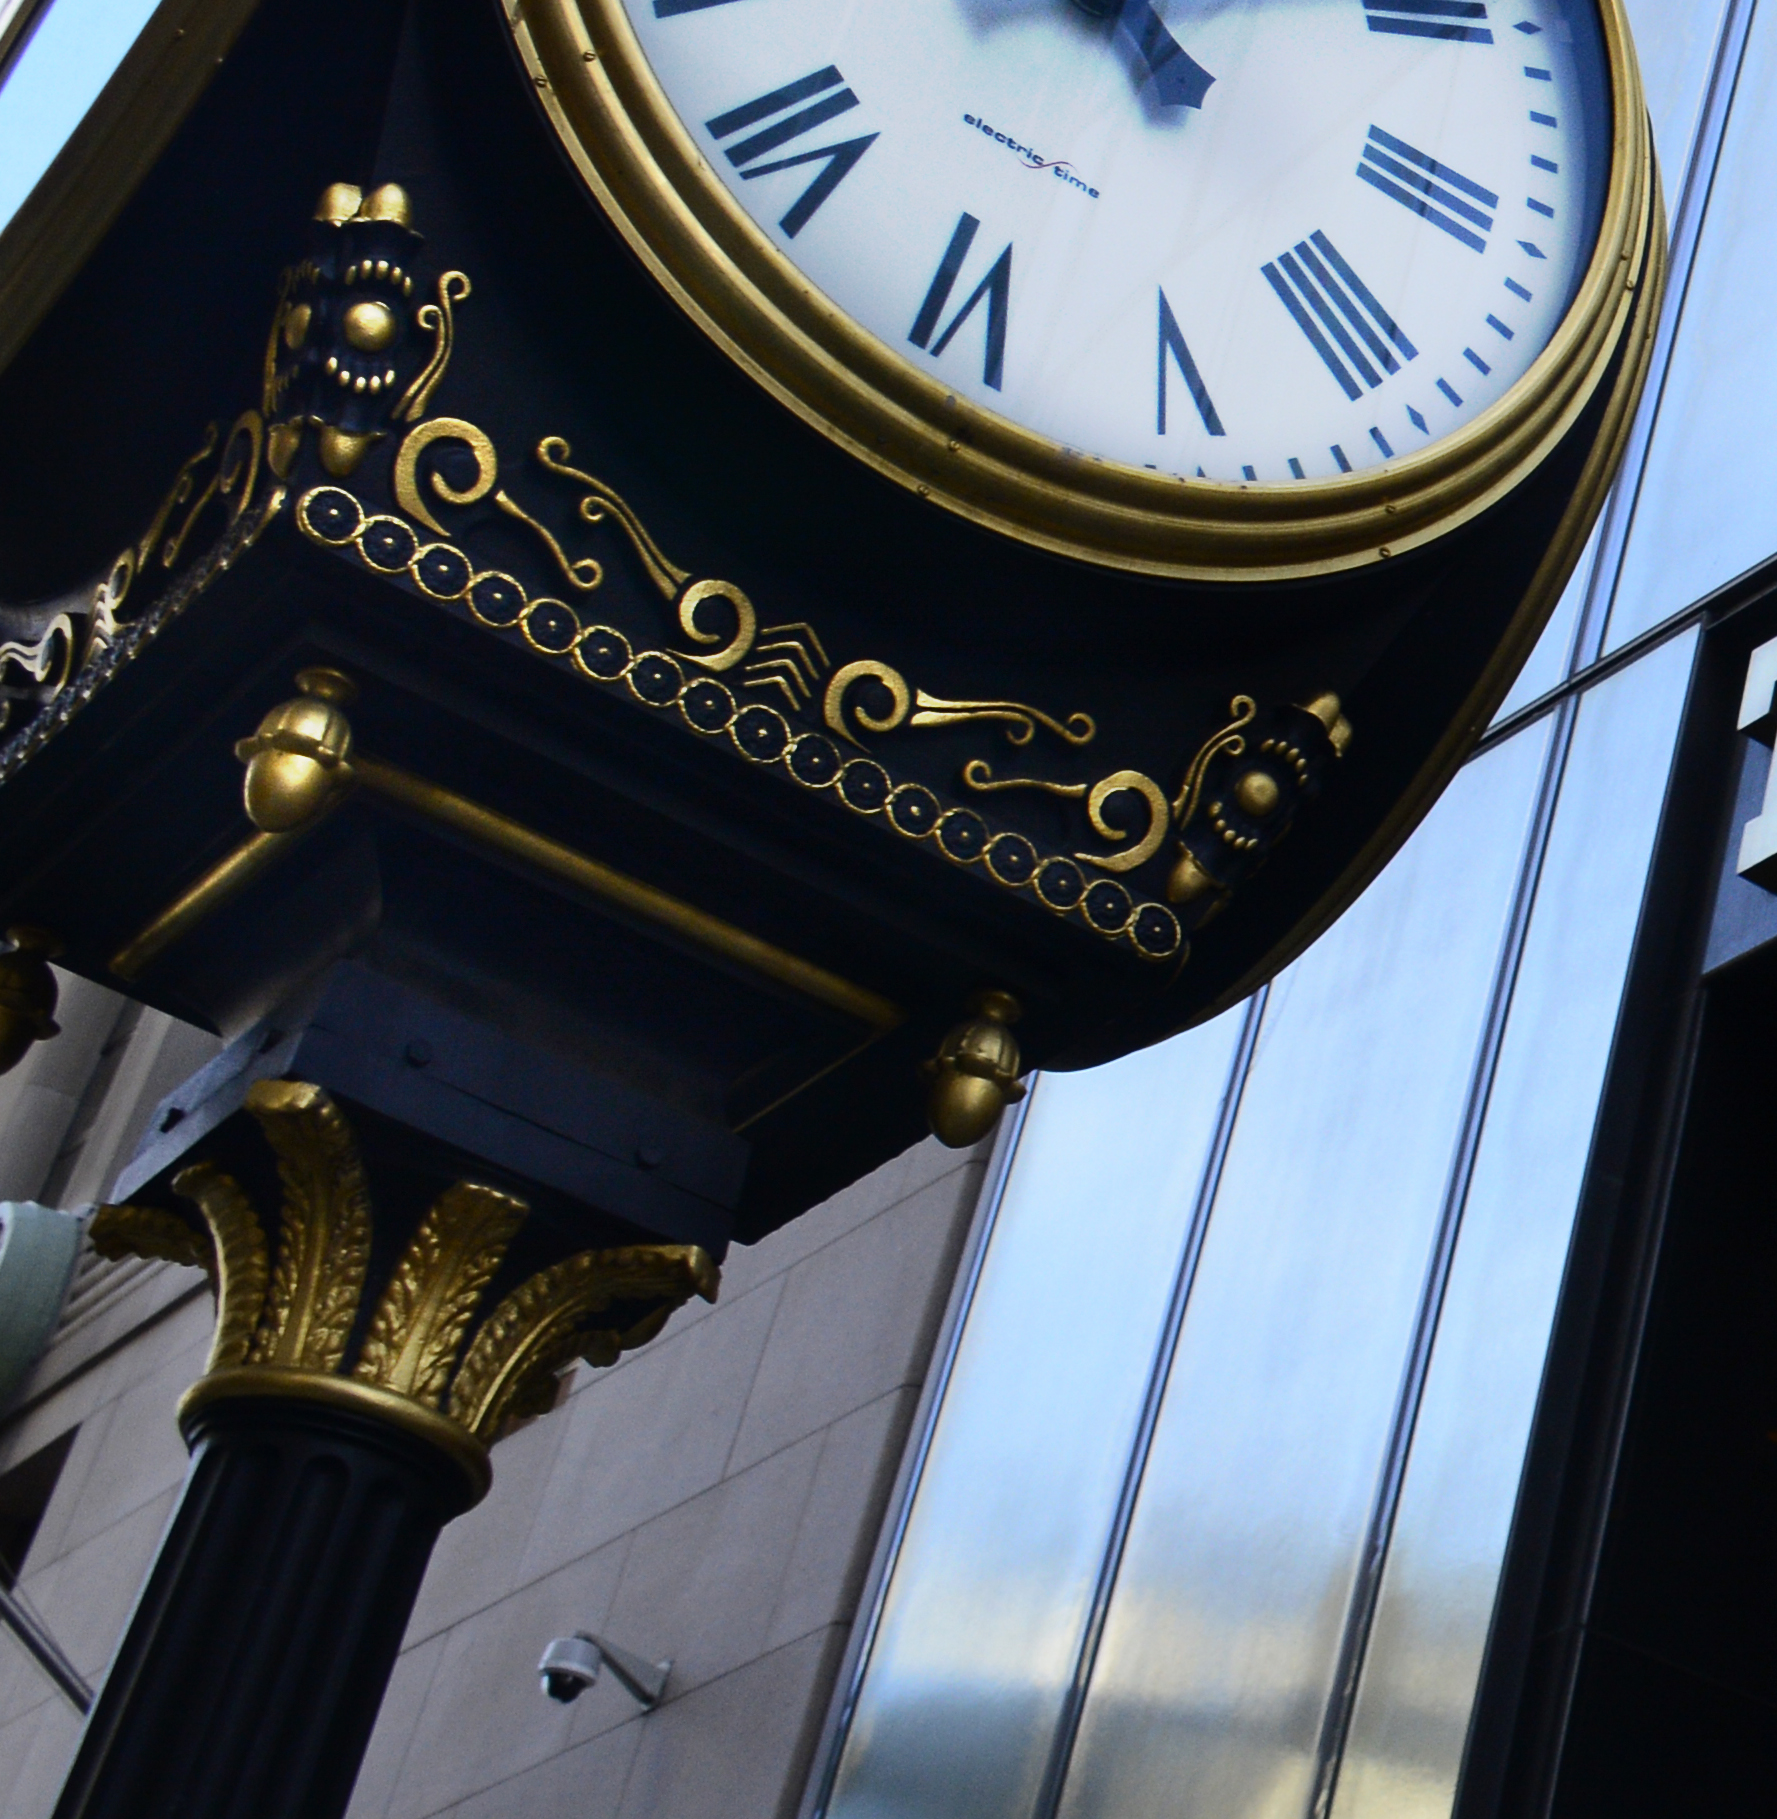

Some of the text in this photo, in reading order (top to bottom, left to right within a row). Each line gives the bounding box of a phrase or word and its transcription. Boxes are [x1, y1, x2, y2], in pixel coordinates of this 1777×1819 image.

[705, 64, 882, 239] VII
[963, 113, 1100, 199] electric time
[1355, 124, 1499, 254] III
[906, 212, 1013, 392] VI
[1156, 287, 1226, 437] V
[1260, 229, 1419, 402] IIII
